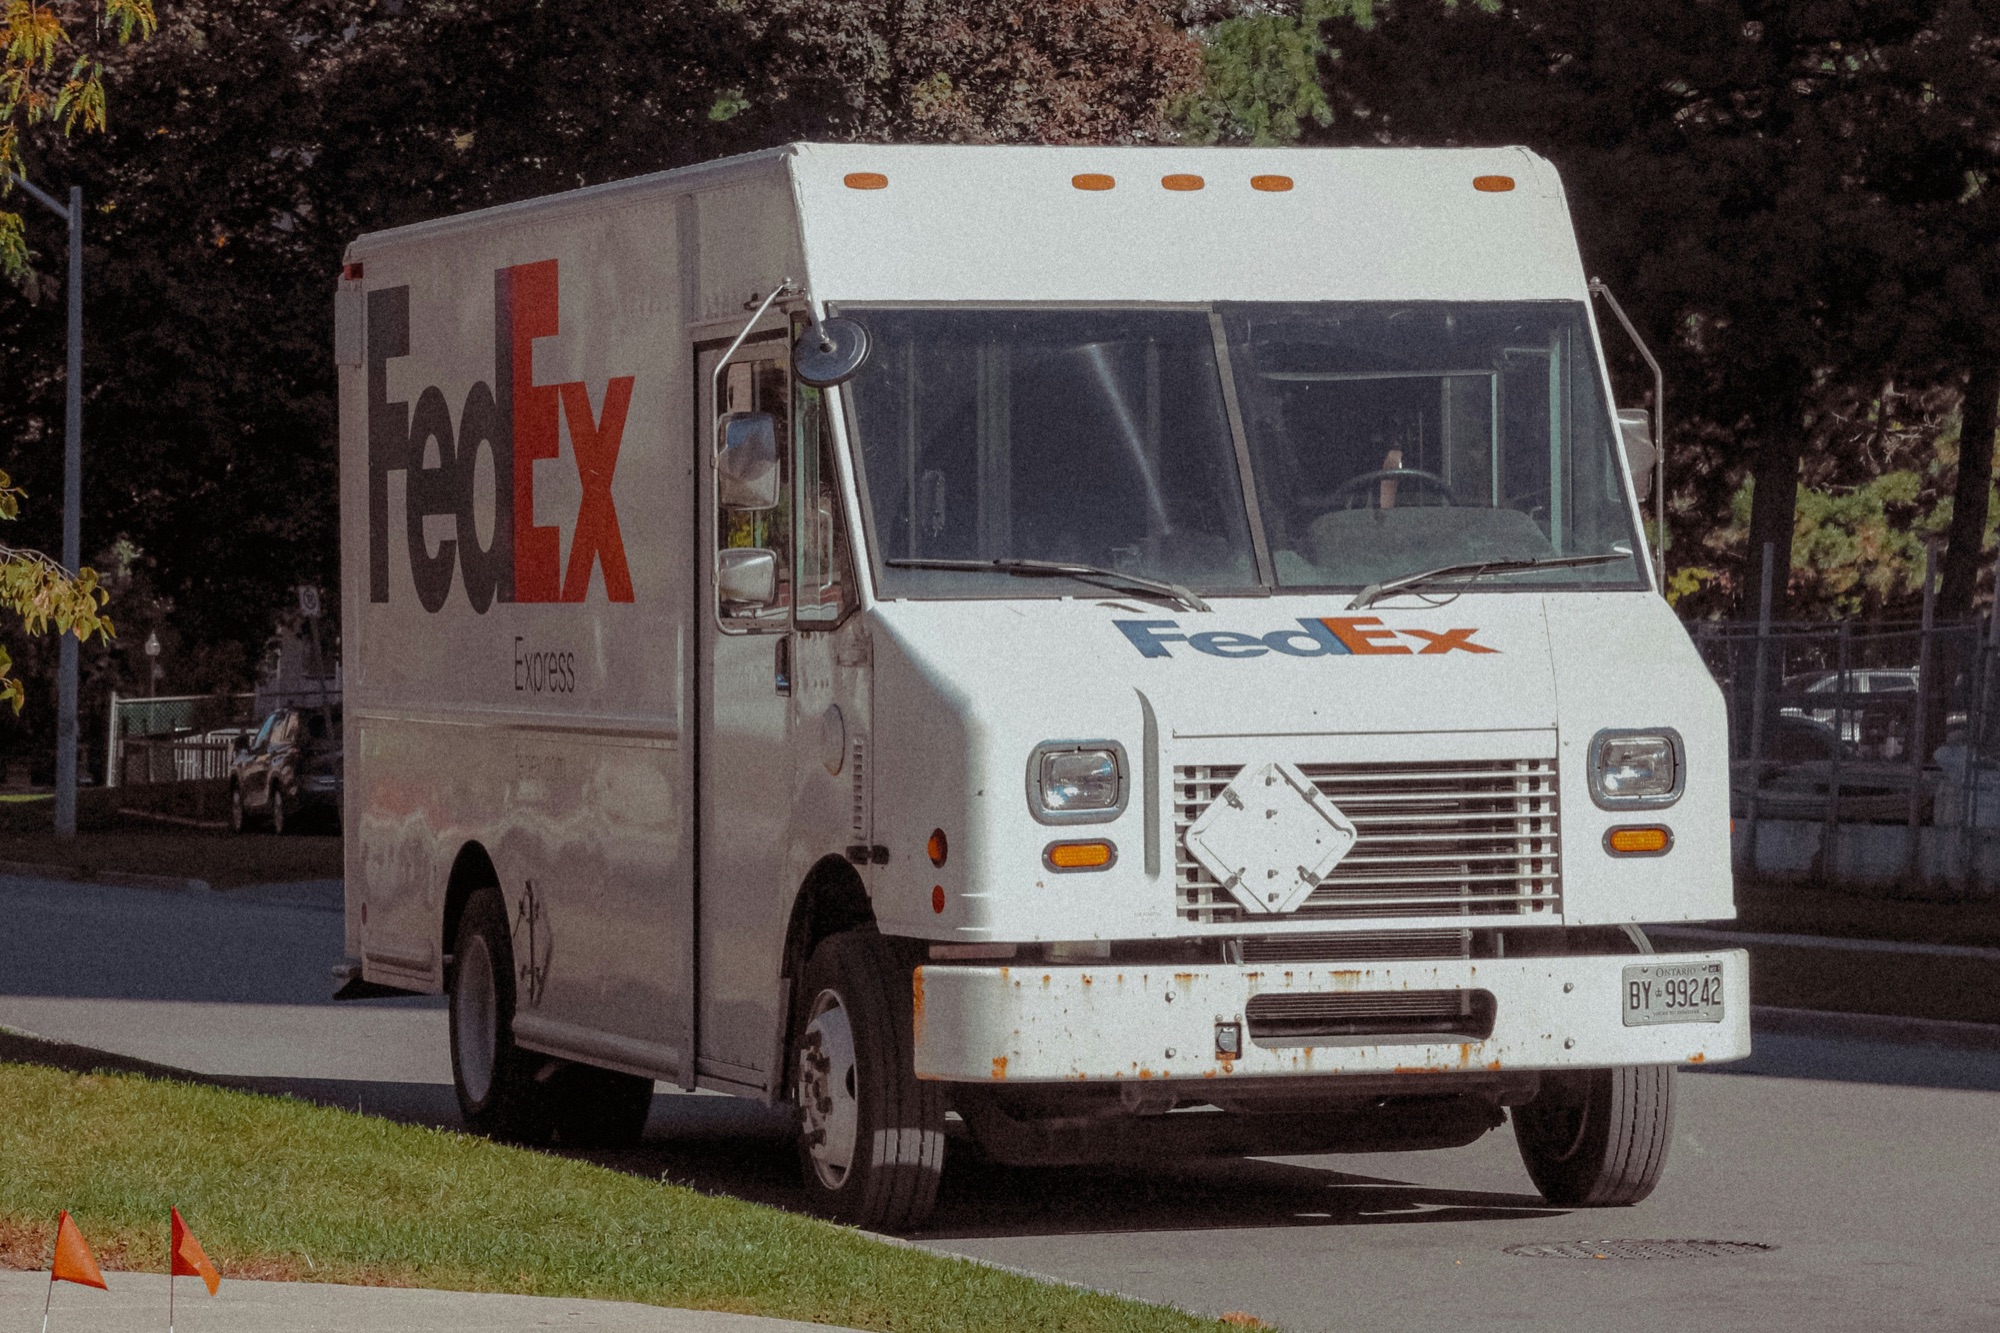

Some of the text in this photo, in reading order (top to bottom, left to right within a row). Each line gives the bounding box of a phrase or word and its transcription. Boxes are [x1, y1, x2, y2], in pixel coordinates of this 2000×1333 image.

[367, 258, 636, 615] FedEx
[1111, 616, 1502, 659] FedEx
[514, 636, 575, 695] Express
[1629, 976, 1722, 1010] BY 99242
